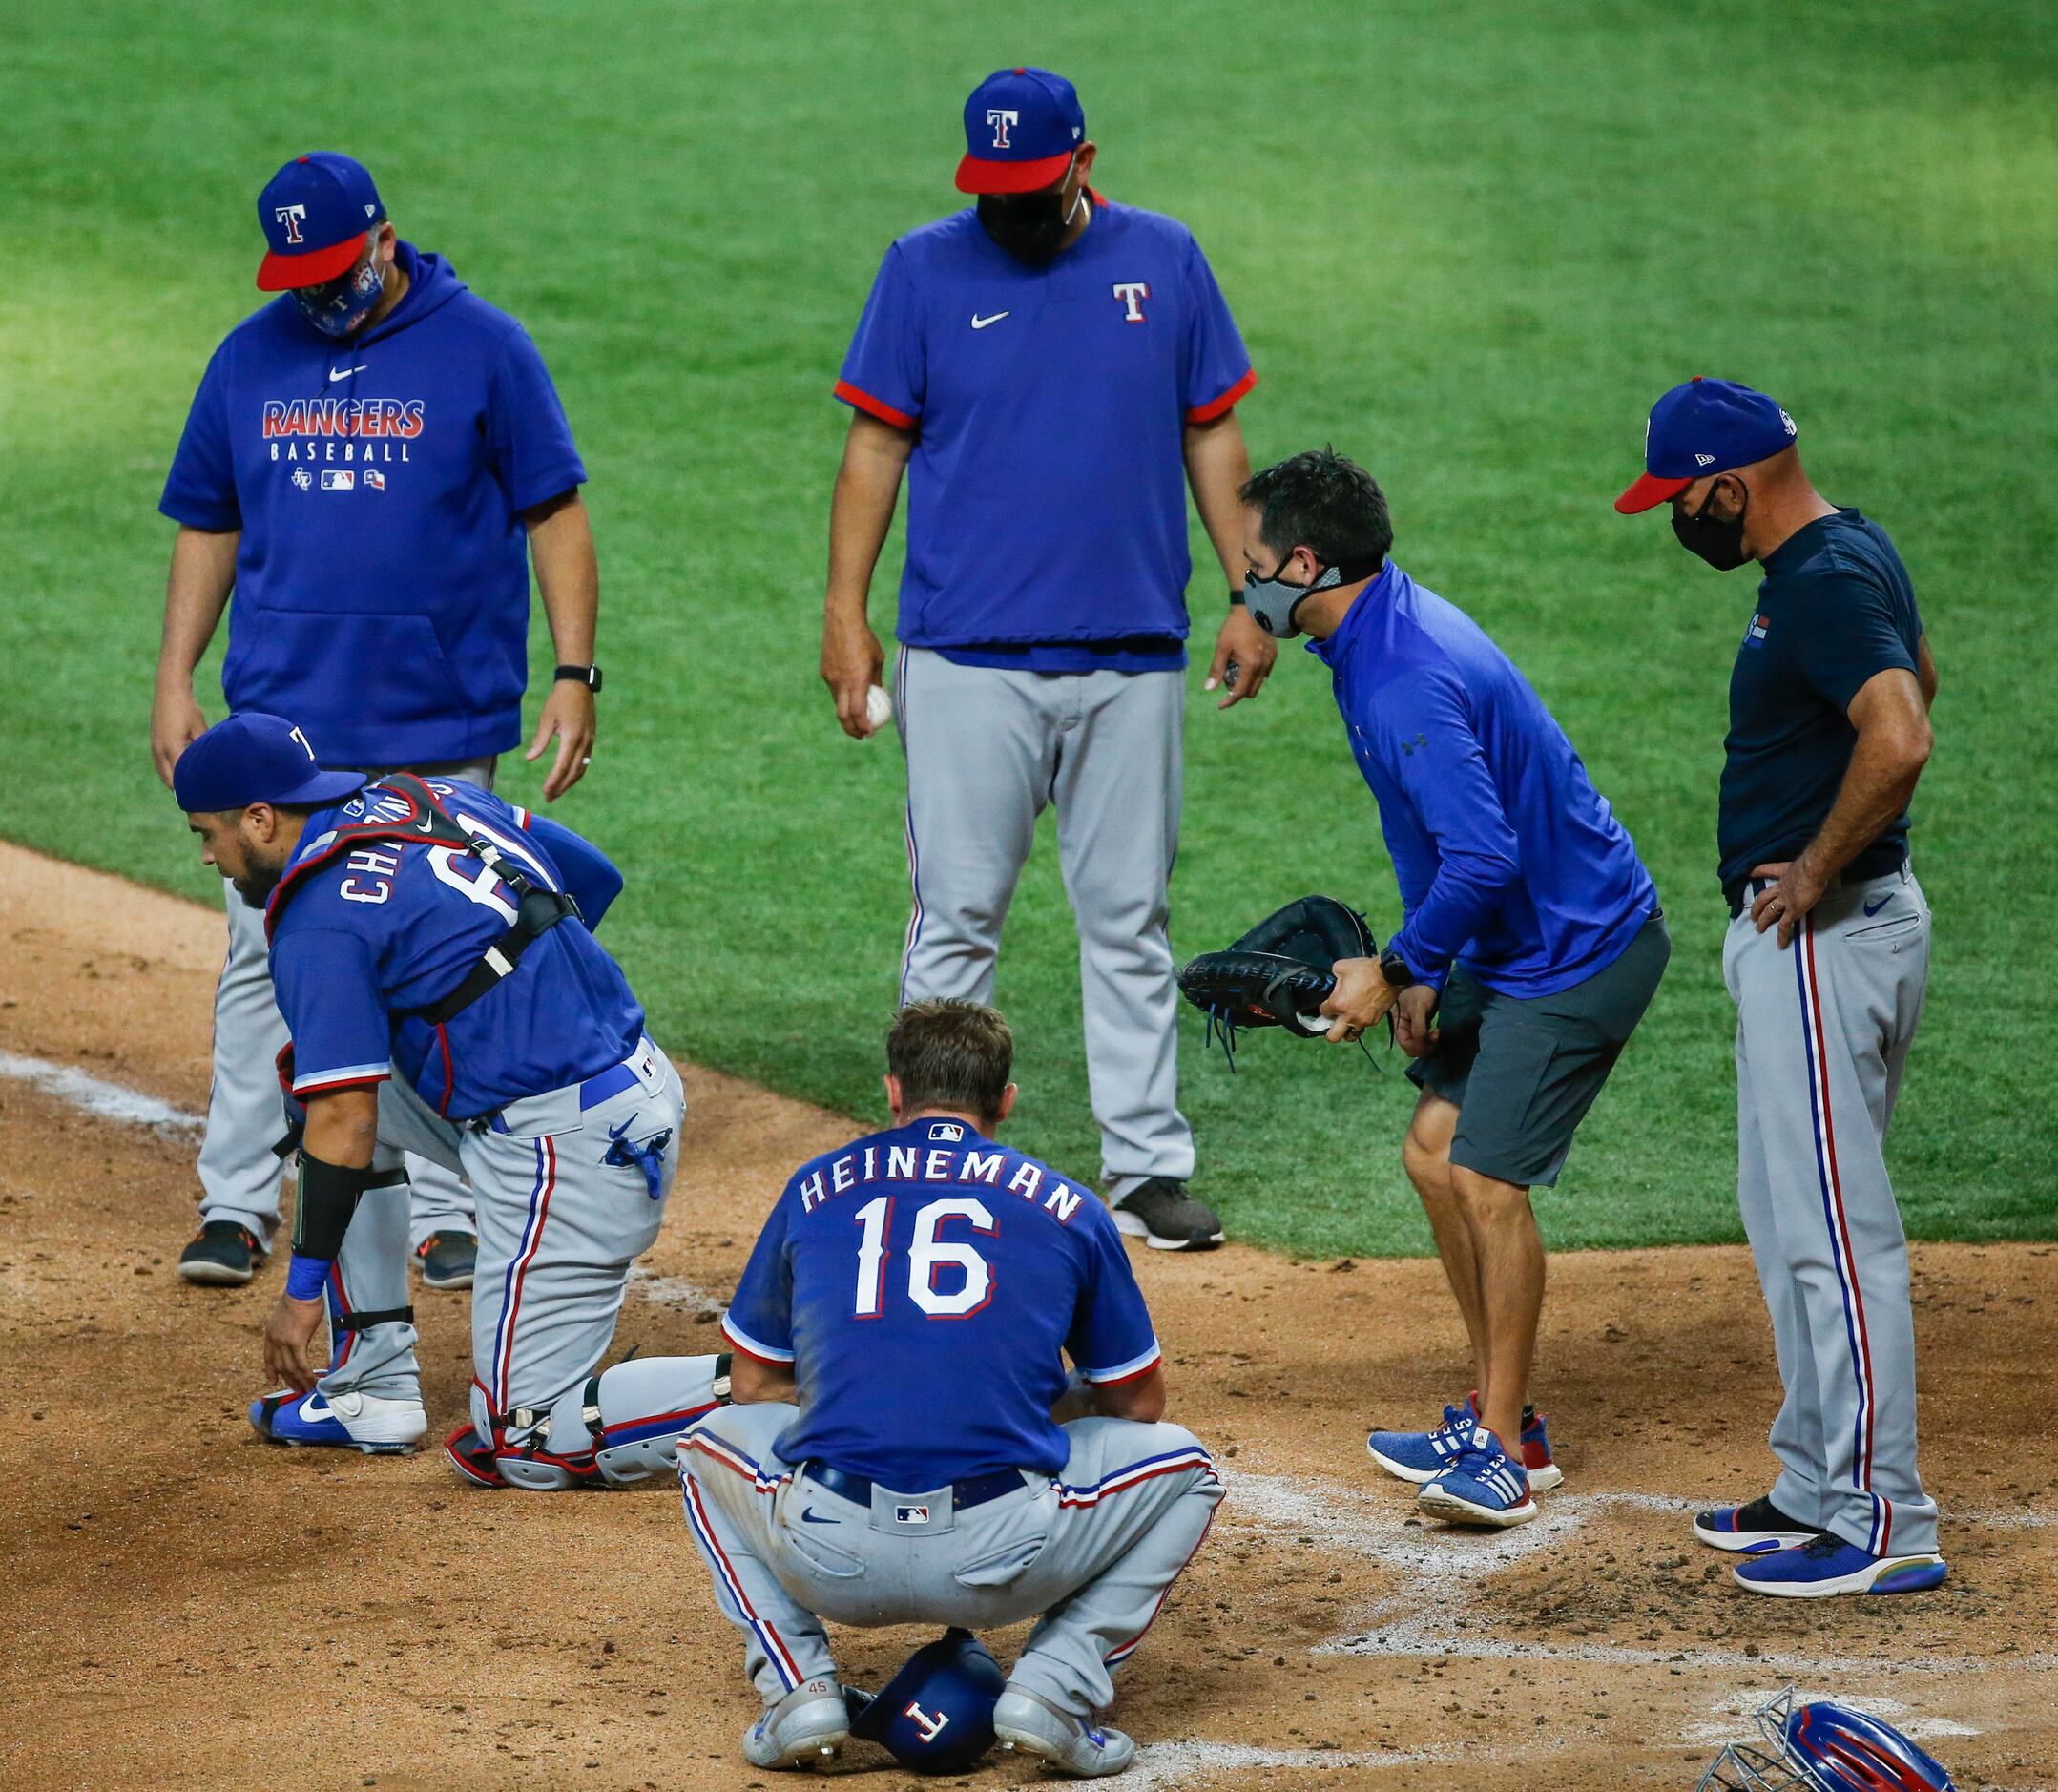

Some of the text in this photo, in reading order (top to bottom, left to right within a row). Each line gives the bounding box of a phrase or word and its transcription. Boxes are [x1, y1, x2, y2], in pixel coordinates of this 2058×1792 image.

[987, 109, 1018, 148] T
[275, 203, 306, 244] T
[1112, 282, 1151, 323] T
[262, 398, 425, 439] RANGERS
[270, 442, 409, 462] BASEBALL
[289, 725, 316, 761] 7
[800, 1145, 1084, 1225] HEINEMAN
[854, 1196, 1000, 1320] 16
[809, 1681, 827, 1694] 45
[903, 1701, 950, 1745] T
